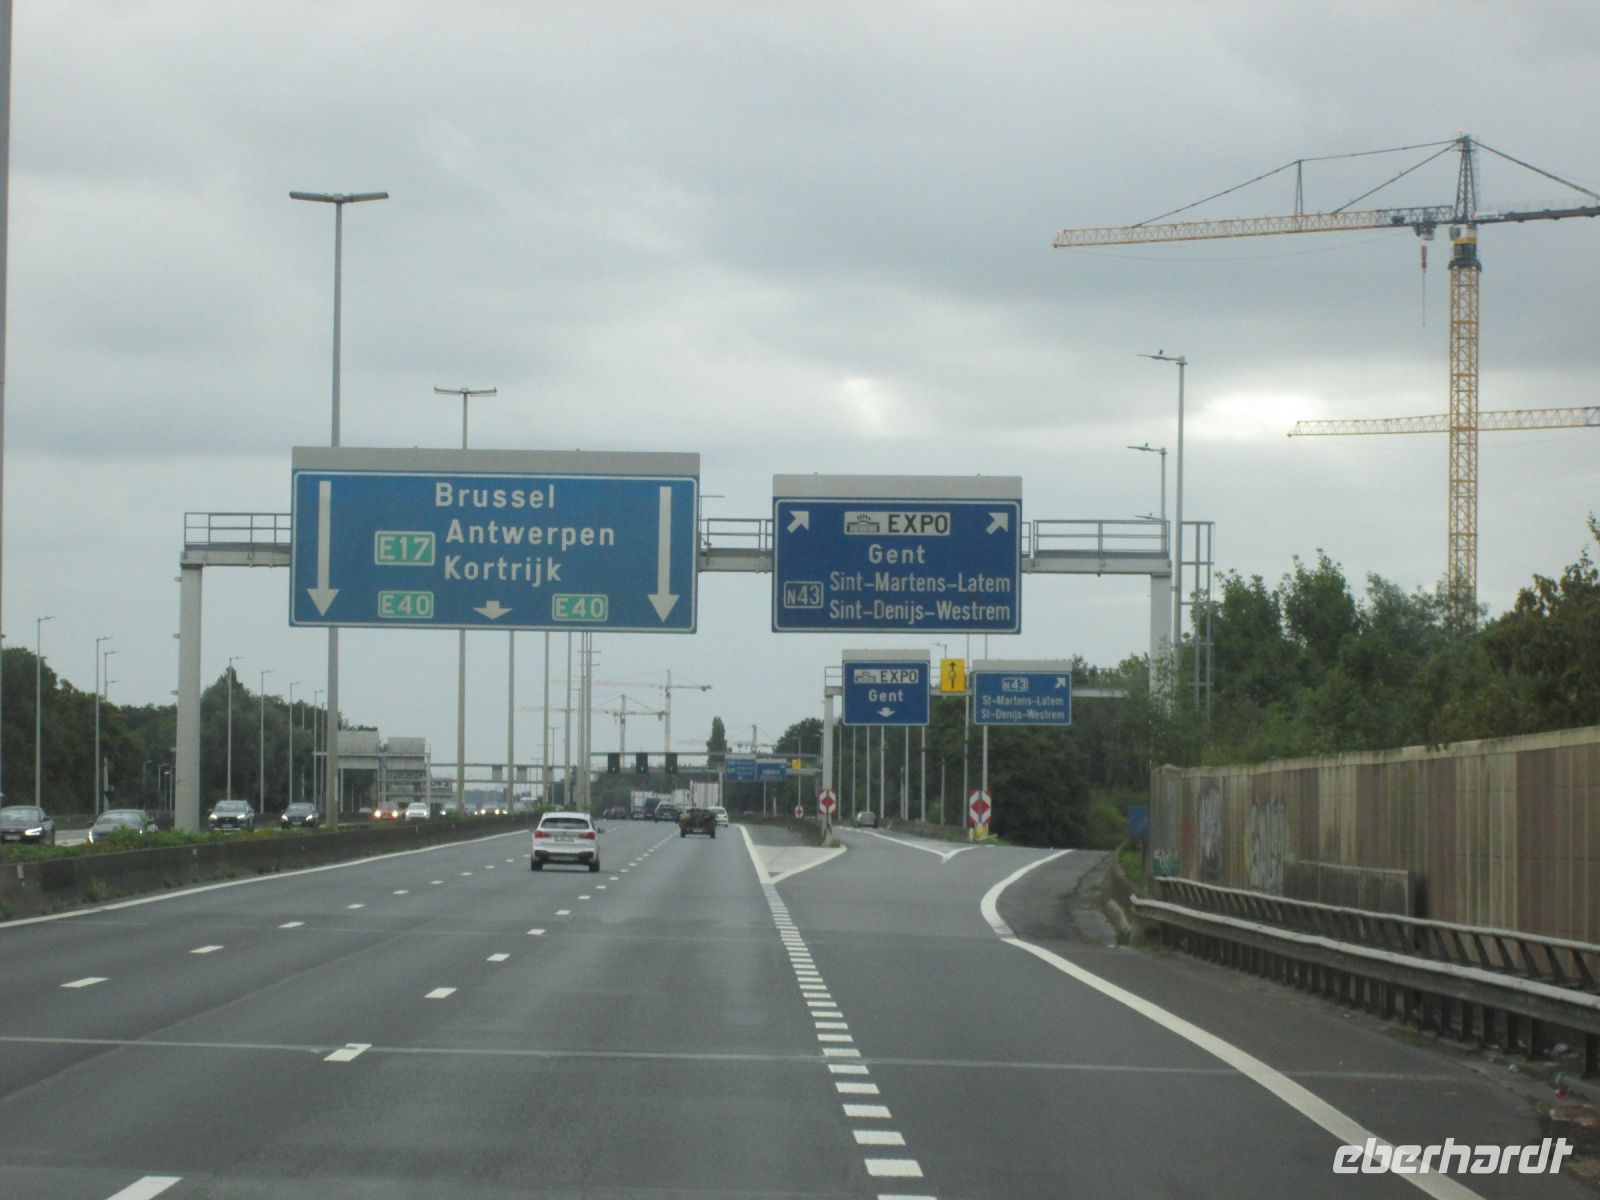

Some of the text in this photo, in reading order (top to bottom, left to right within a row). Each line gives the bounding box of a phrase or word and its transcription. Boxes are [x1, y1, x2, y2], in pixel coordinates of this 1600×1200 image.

[435, 482, 556, 509] Brussel
[446, 518, 615, 551] Antwerpen
[888, 514, 948, 533] EXPO
[379, 535, 431, 561] E17
[868, 543, 926, 565] Gent
[444, 555, 562, 588] Kortrijk
[829, 571, 1011, 593] Sint-Martens-Latem
[381, 595, 431, 615] E40
[787, 585, 821, 606] N43
[555, 598, 605, 618] E40
[829, 599, 1011, 625] Sint-Denijs-Westrem
[880, 670, 918, 683] EXPO
[868, 689, 904, 703] Gent
